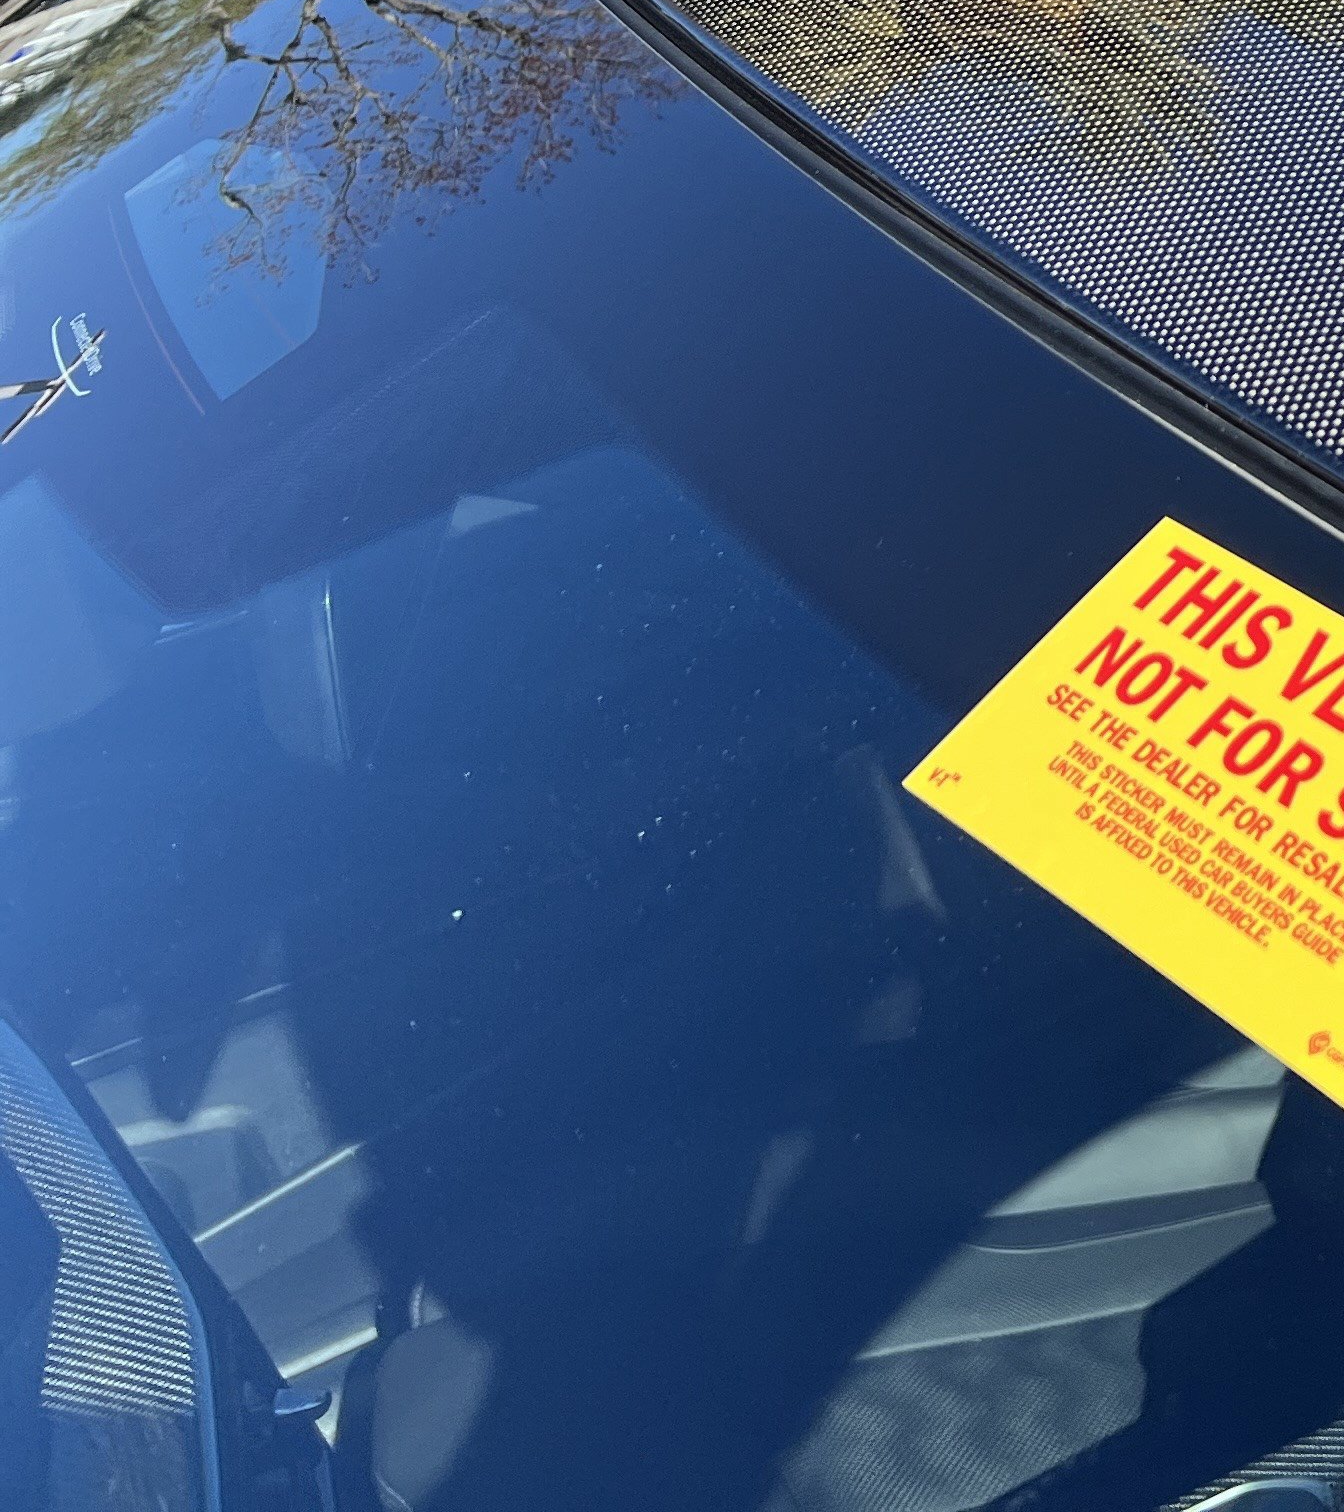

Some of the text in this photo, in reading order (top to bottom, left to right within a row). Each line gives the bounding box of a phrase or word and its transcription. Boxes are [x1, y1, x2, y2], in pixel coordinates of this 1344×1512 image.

[1134, 547, 1294, 671] THIS
[1048, 685, 1096, 723] SEE
[1091, 710, 1140, 752] THE
[1132, 740, 1222, 808] DEALER
[1219, 796, 1275, 843] FOR
[1075, 627, 1210, 724] NOT
[1187, 697, 1326, 810] FOR
[1049, 757, 1344, 966] UNTIL A FEDERAL USED CAR BUYERS GUIDE
[1067, 741, 1104, 772] THIS
[1100, 765, 1167, 815] STICKER
[1164, 807, 1216, 846] MUST
[1212, 839, 1282, 893] REMAIN
[1278, 885, 1302, 907] IN
[1076, 803, 1272, 948] IS AFFIXED TO THIS VEHICLE.
